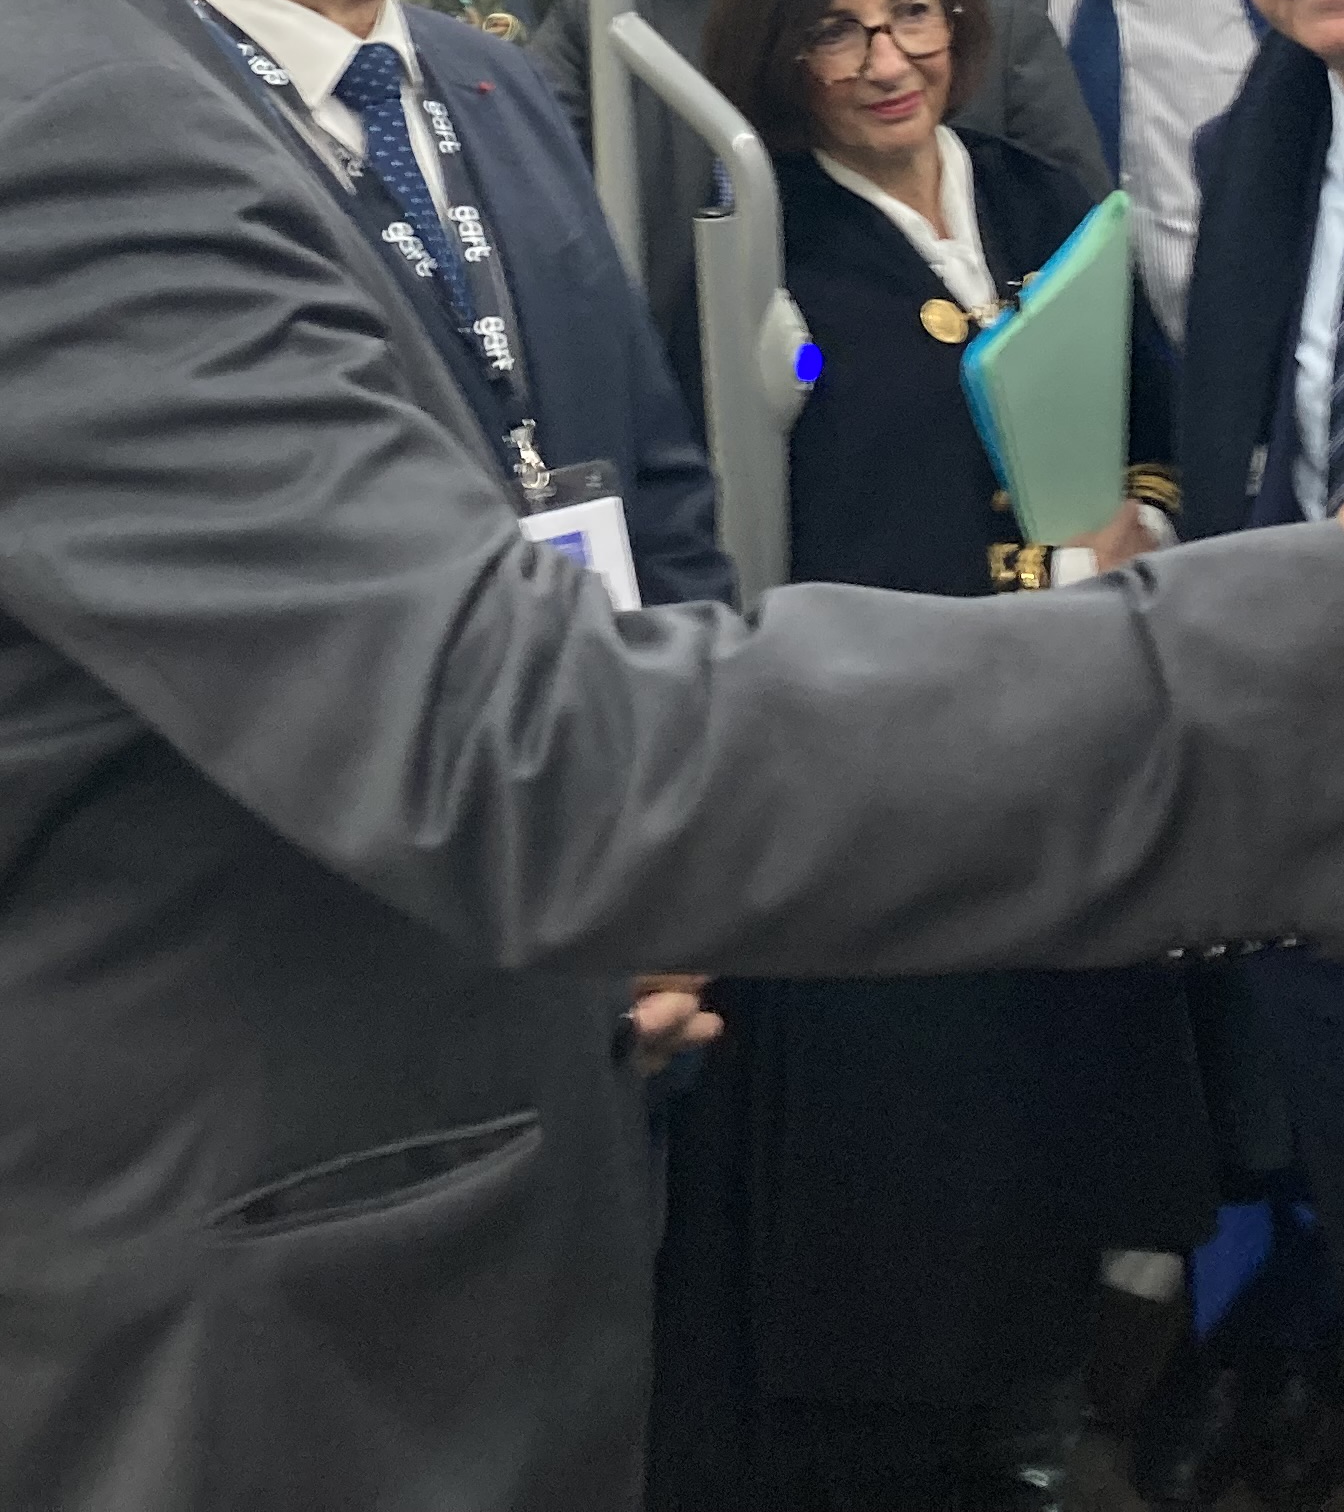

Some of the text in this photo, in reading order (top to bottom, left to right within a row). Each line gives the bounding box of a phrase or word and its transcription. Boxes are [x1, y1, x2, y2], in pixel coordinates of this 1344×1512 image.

[422, 99, 462, 155] gart
[381, 221, 438, 278] gart
[447, 205, 492, 263] gart
[473, 315, 516, 372] gart
